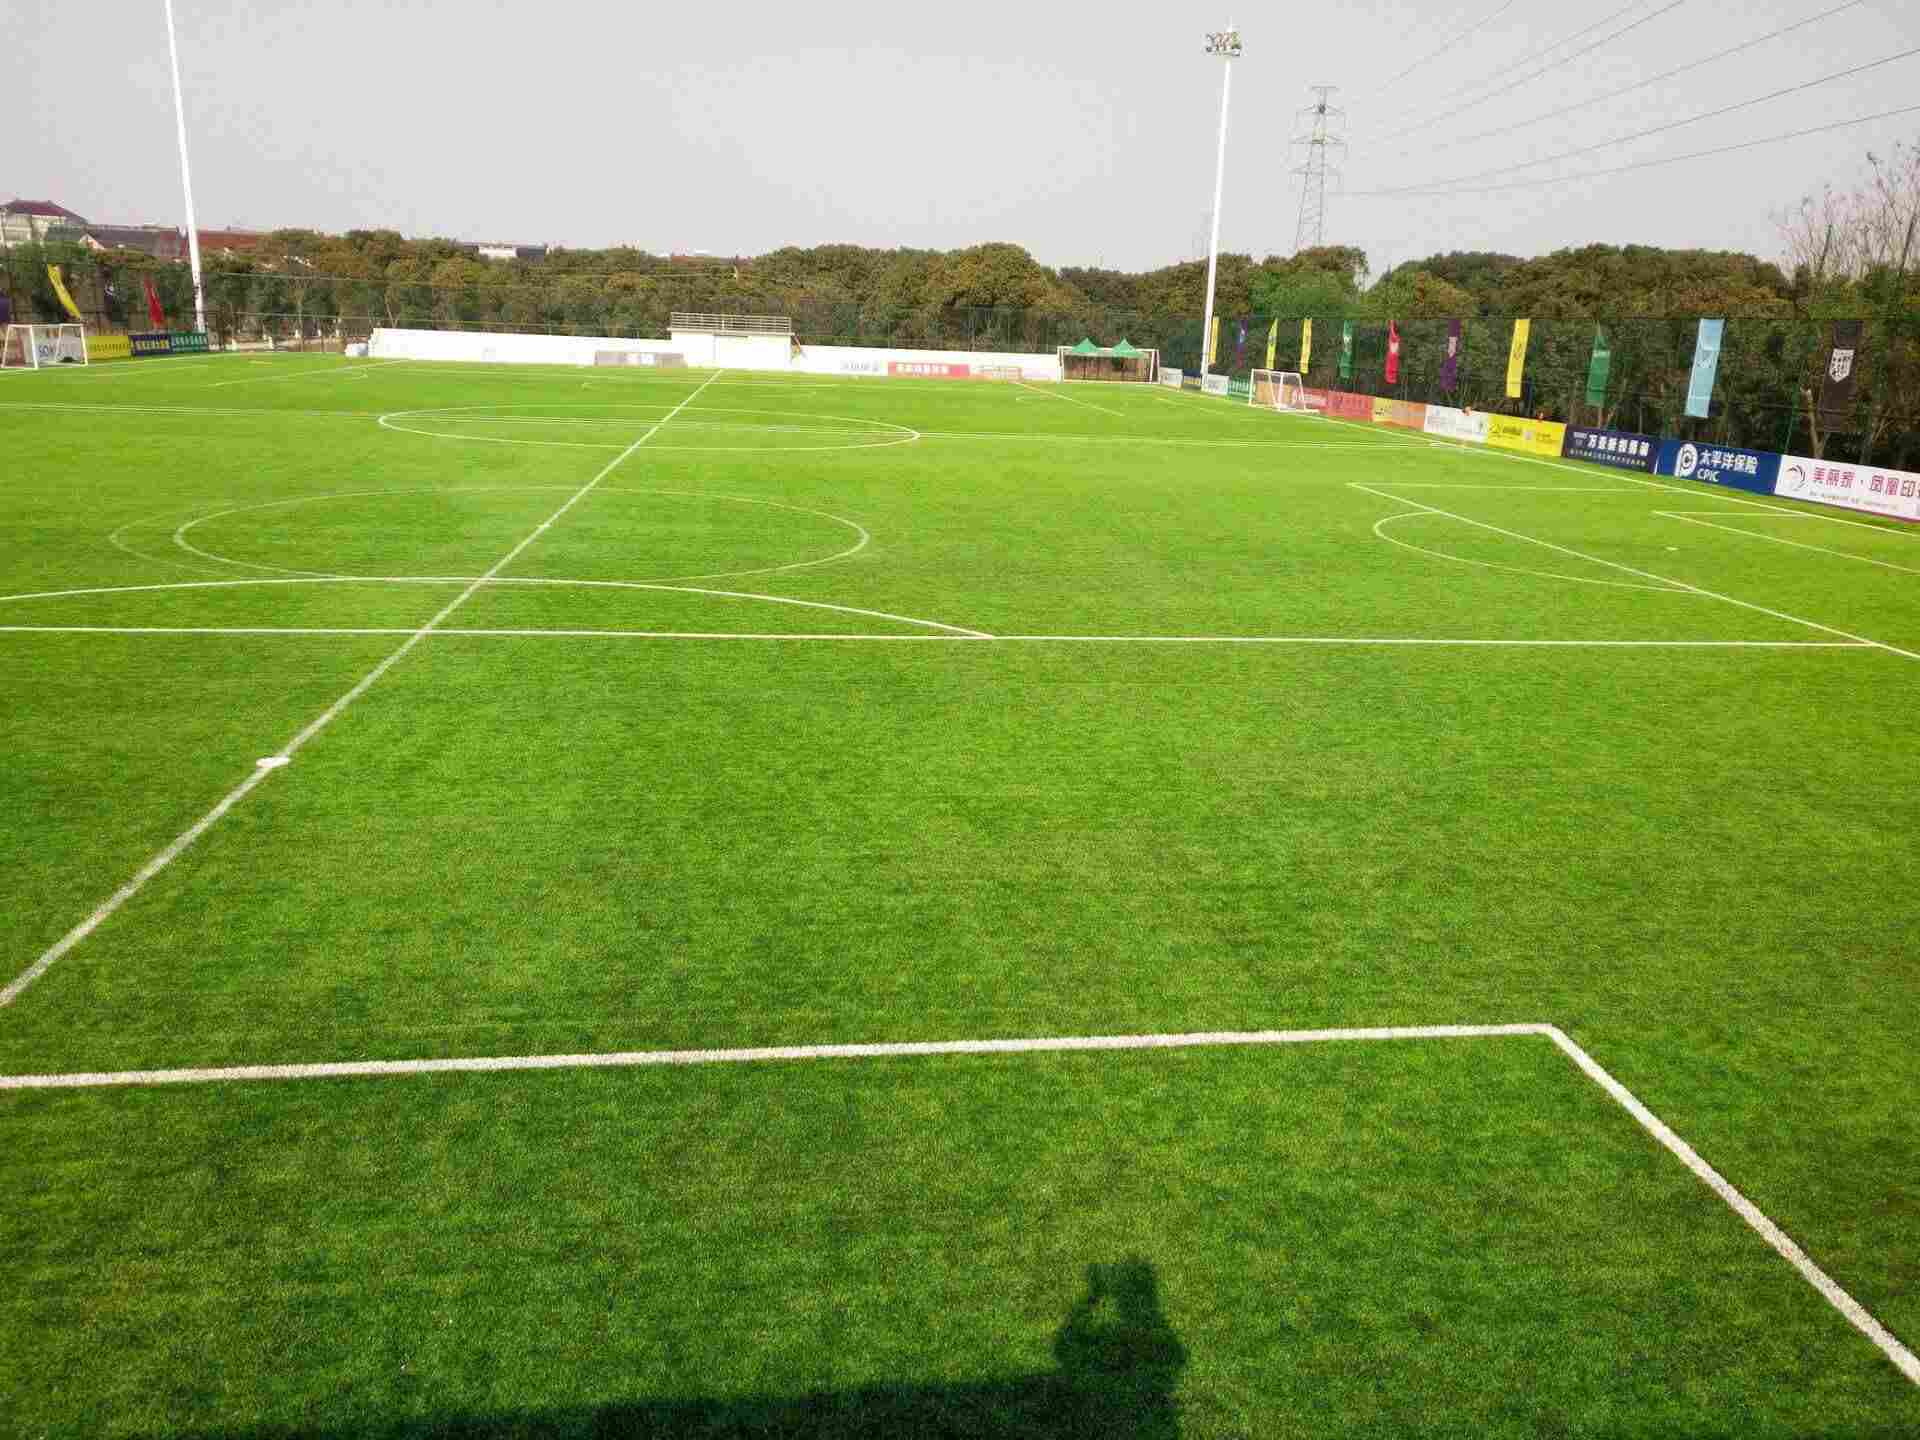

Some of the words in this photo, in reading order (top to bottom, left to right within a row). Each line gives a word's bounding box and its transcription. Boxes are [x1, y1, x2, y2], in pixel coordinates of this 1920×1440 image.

[1699, 449, 1758, 474] 太平洋保险
[1697, 468, 1721, 482] CPIC
